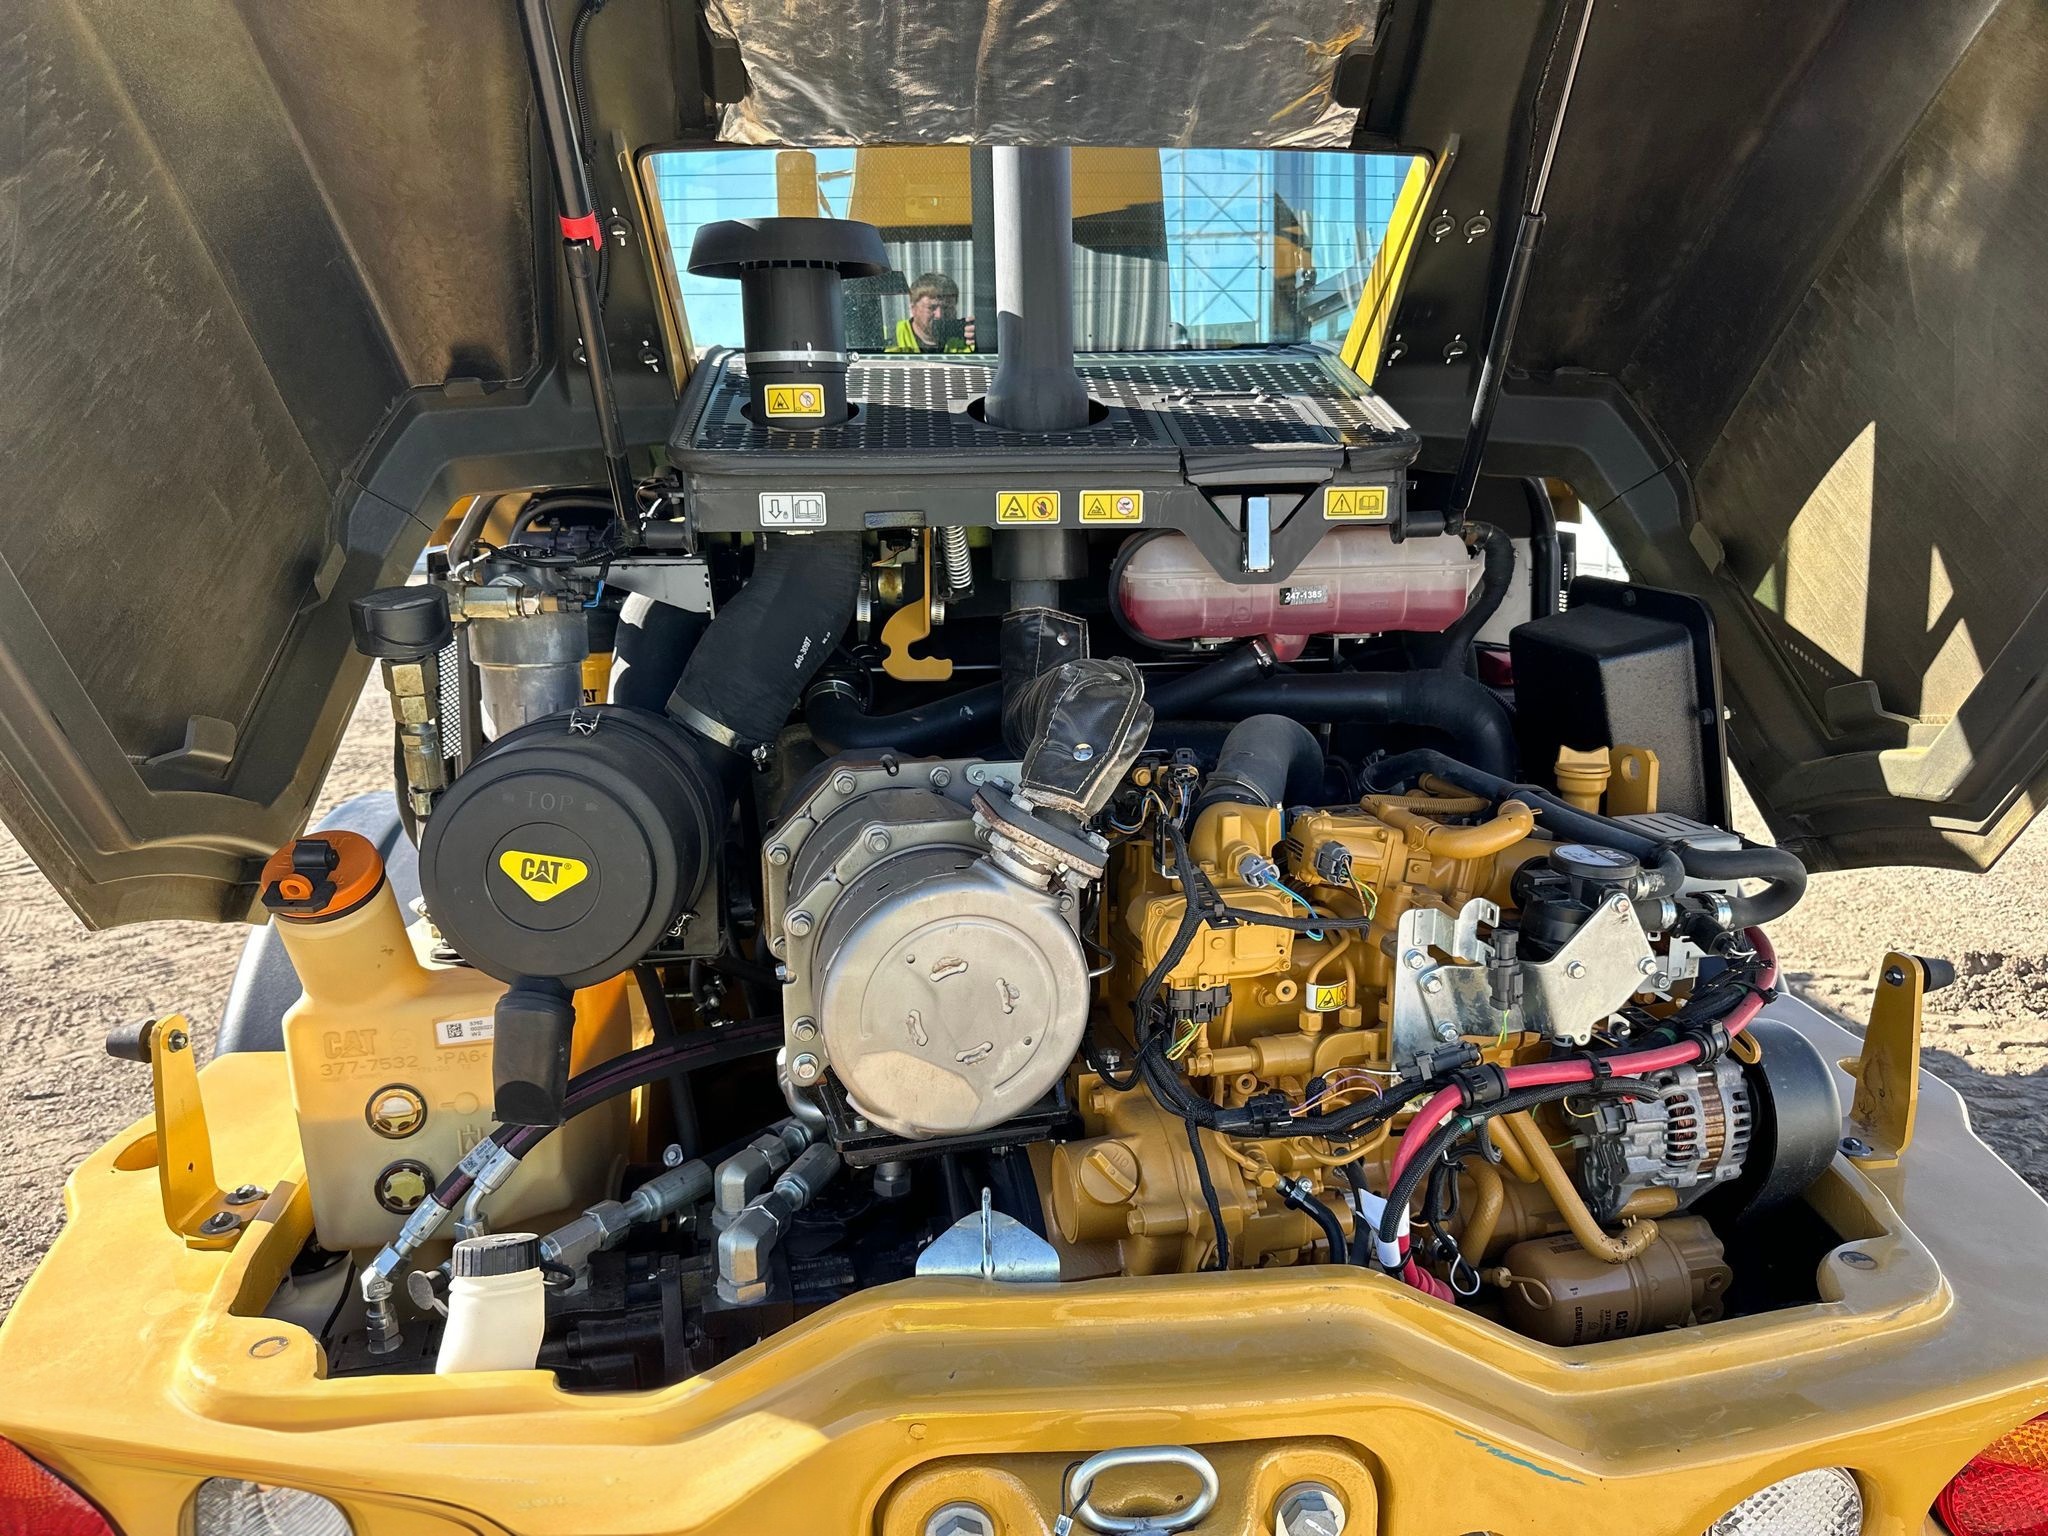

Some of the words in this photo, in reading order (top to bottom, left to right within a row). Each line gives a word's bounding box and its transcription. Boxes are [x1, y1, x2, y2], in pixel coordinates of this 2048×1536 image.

[1285, 590, 1322, 600] 247-1385
[583, 688, 597, 703] AT
[524, 790, 575, 812] TOP
[323, 1029, 377, 1059] CAT
[320, 1056, 418, 1076] 377-7532
